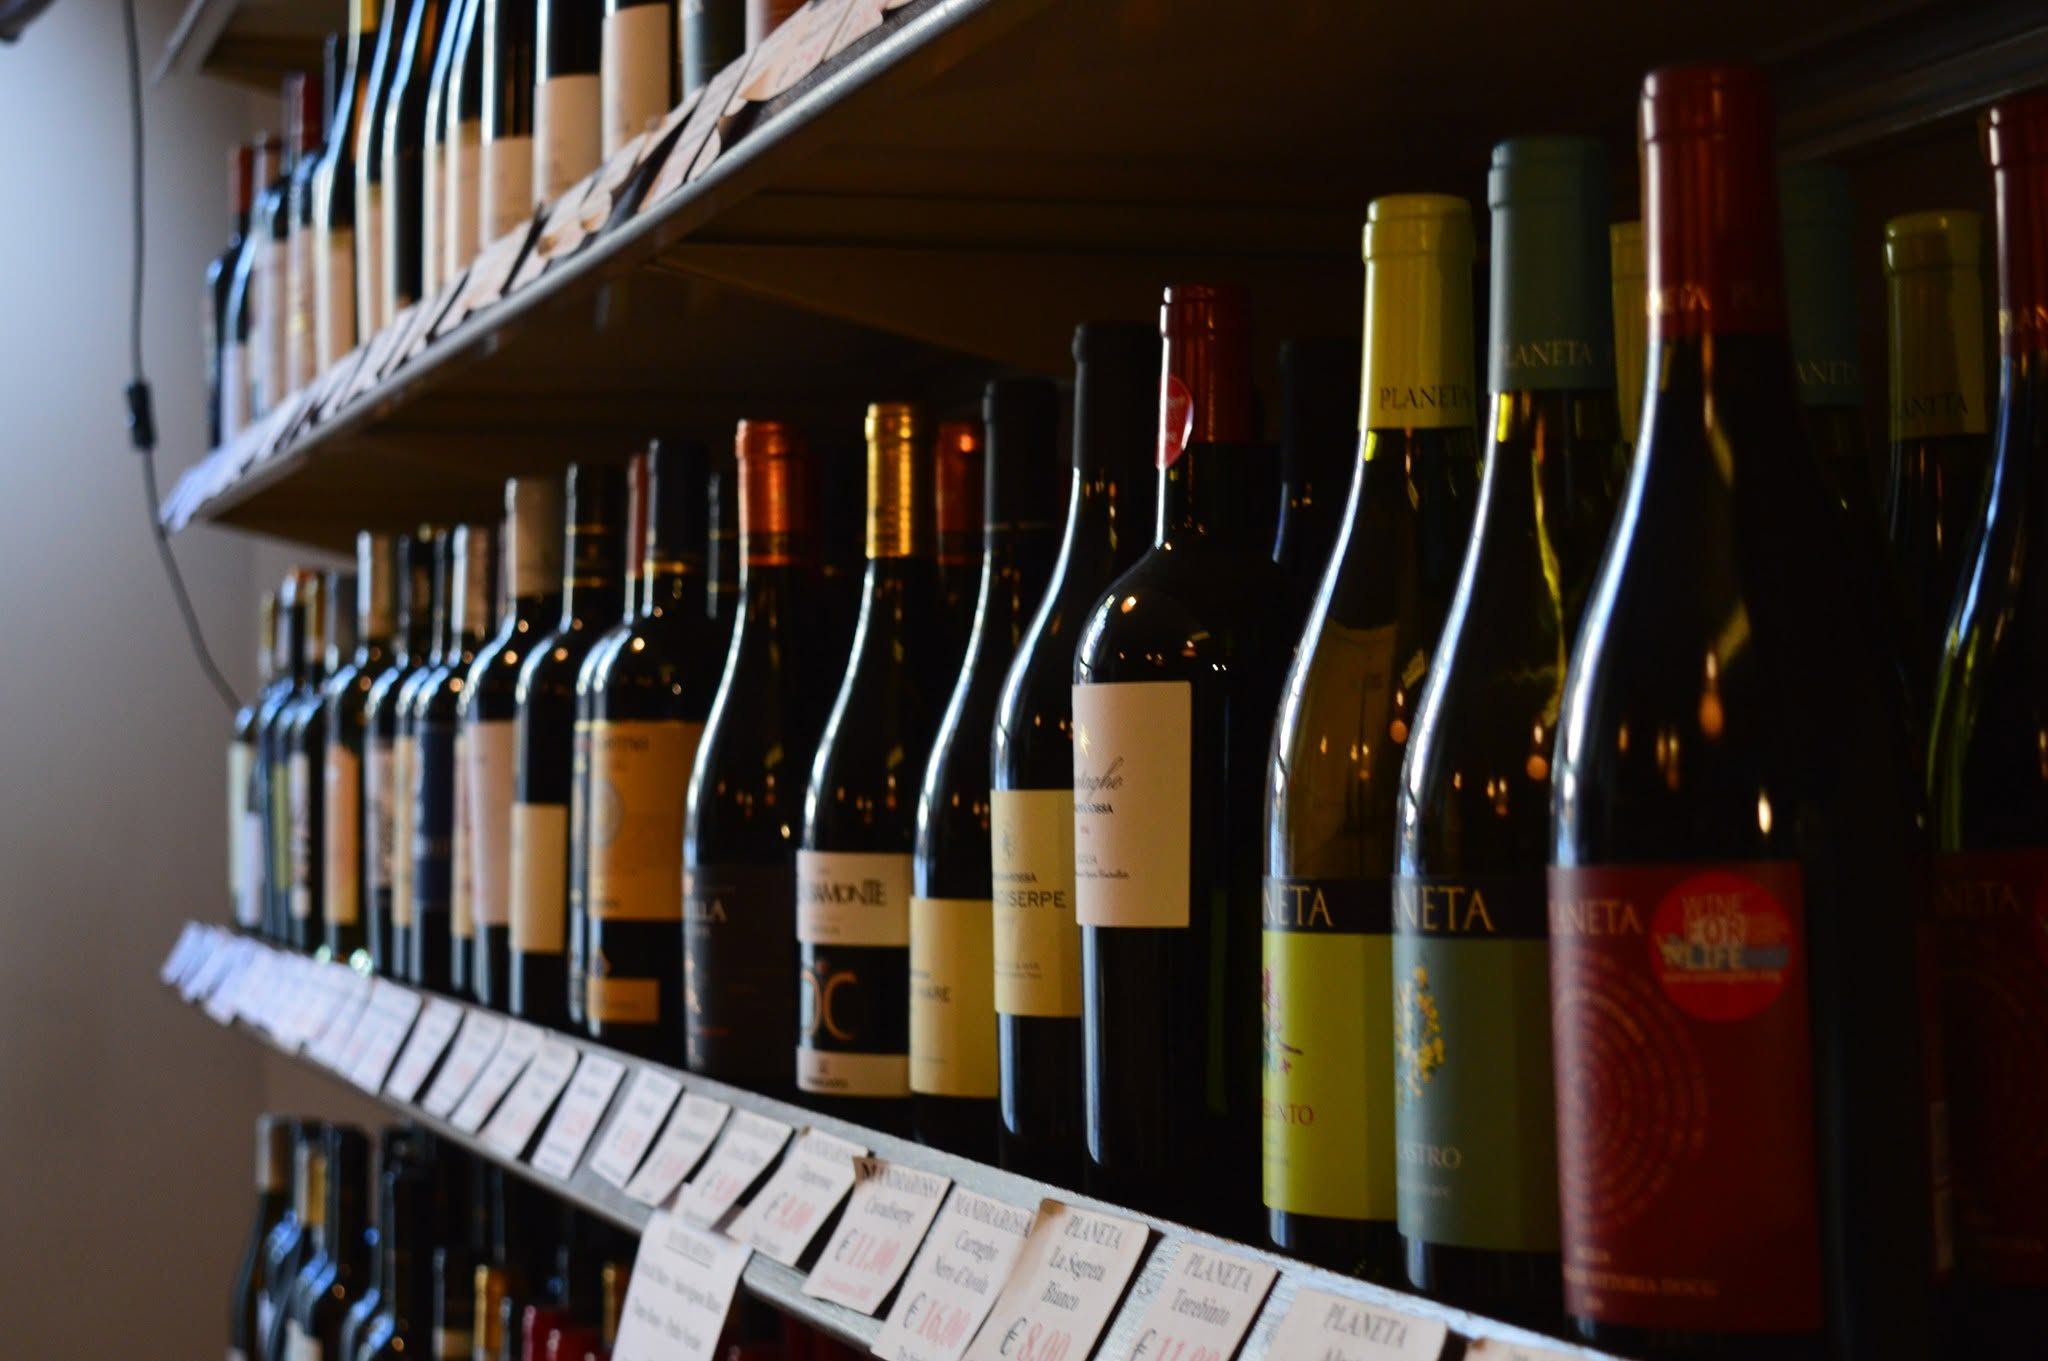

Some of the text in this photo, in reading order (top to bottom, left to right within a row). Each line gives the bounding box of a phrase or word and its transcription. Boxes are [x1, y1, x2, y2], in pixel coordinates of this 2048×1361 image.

[1064, 1214, 1124, 1250] PLANETA
[1184, 1252, 1253, 1293] PLANETA
[903, 1290, 927, 1330] €
[1323, 1302, 1409, 1350] PLANETA
[1000, 1316, 1028, 1356] €
